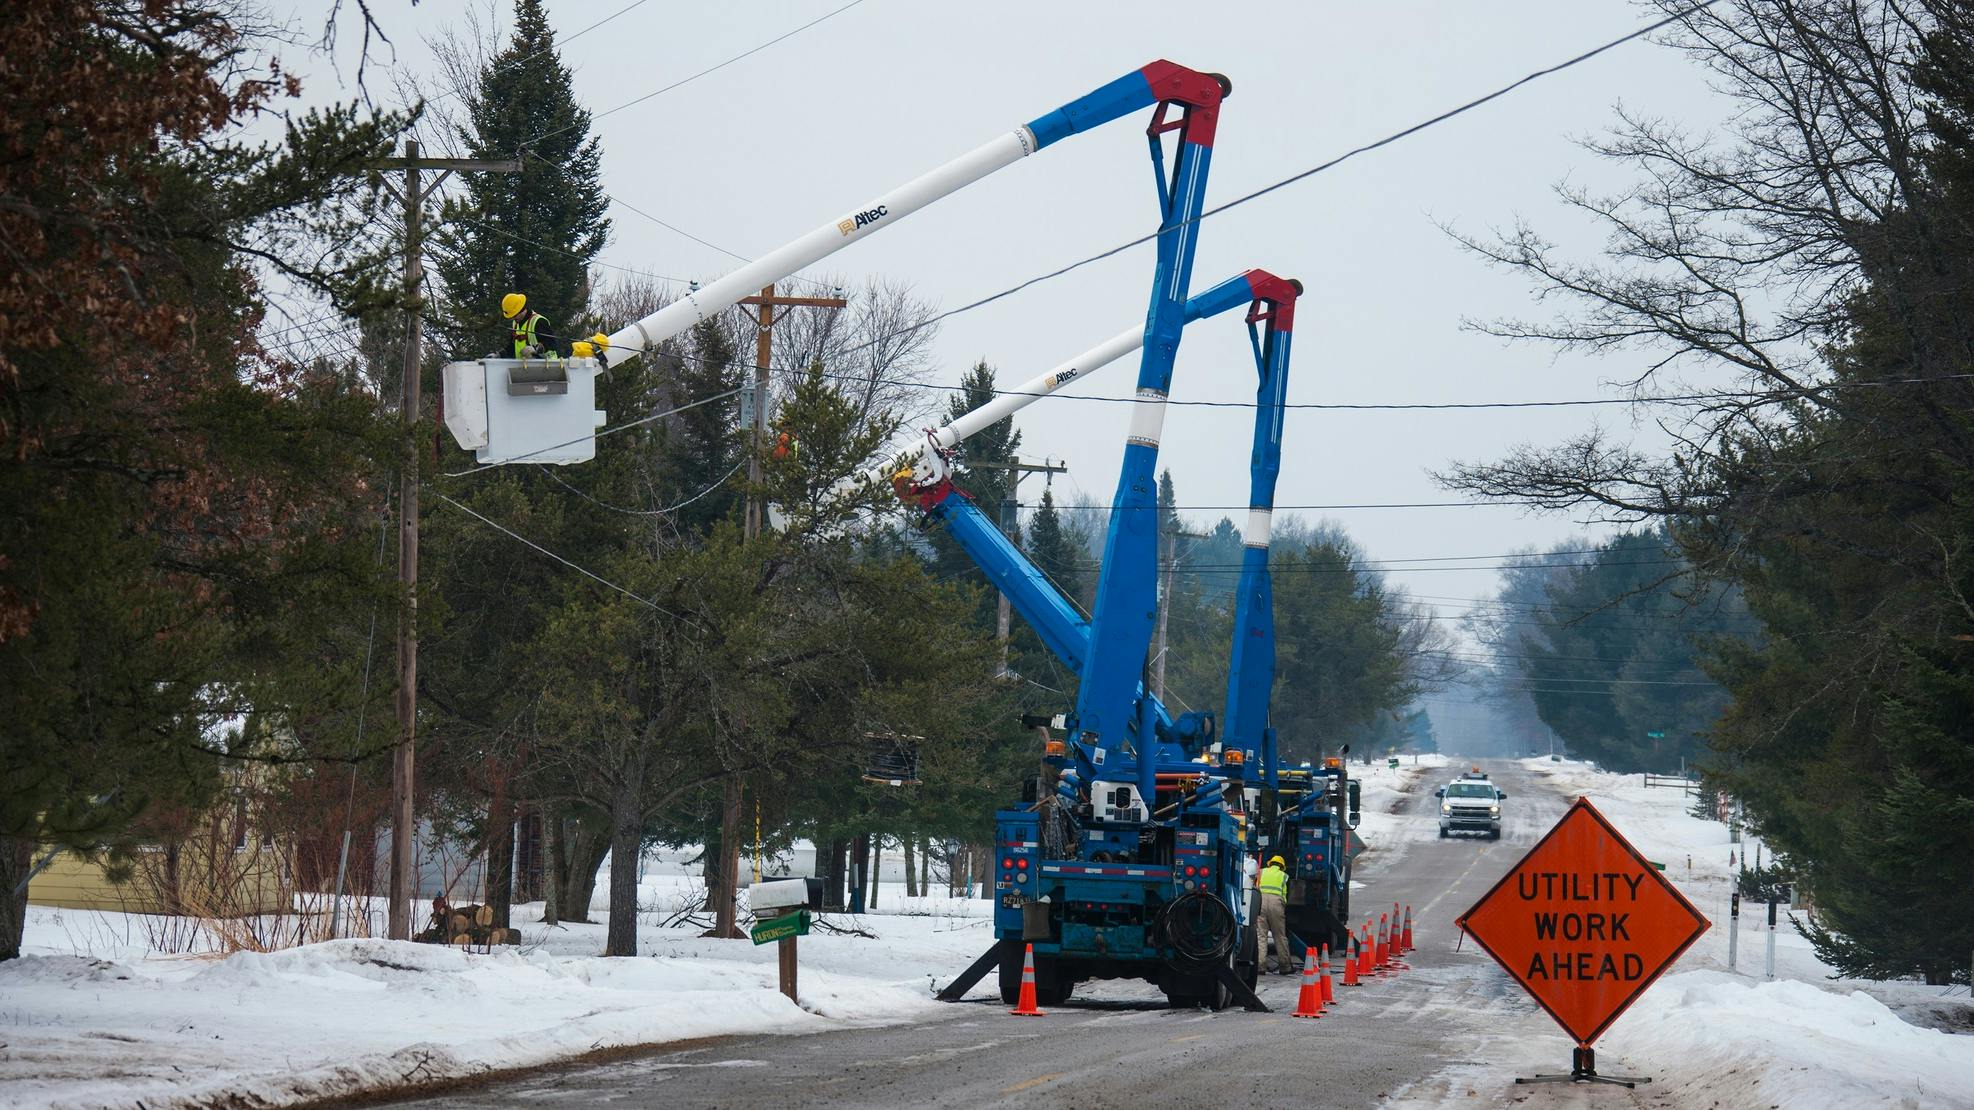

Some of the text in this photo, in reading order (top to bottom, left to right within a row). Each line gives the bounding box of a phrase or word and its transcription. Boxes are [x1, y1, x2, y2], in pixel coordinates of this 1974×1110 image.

[855, 205, 888, 229] Altec
[1056, 368, 1077, 384] Altec
[1518, 872, 1645, 901] UTILITY
[1534, 912, 1631, 941] WORK
[1526, 952, 1644, 981] AHEAD
